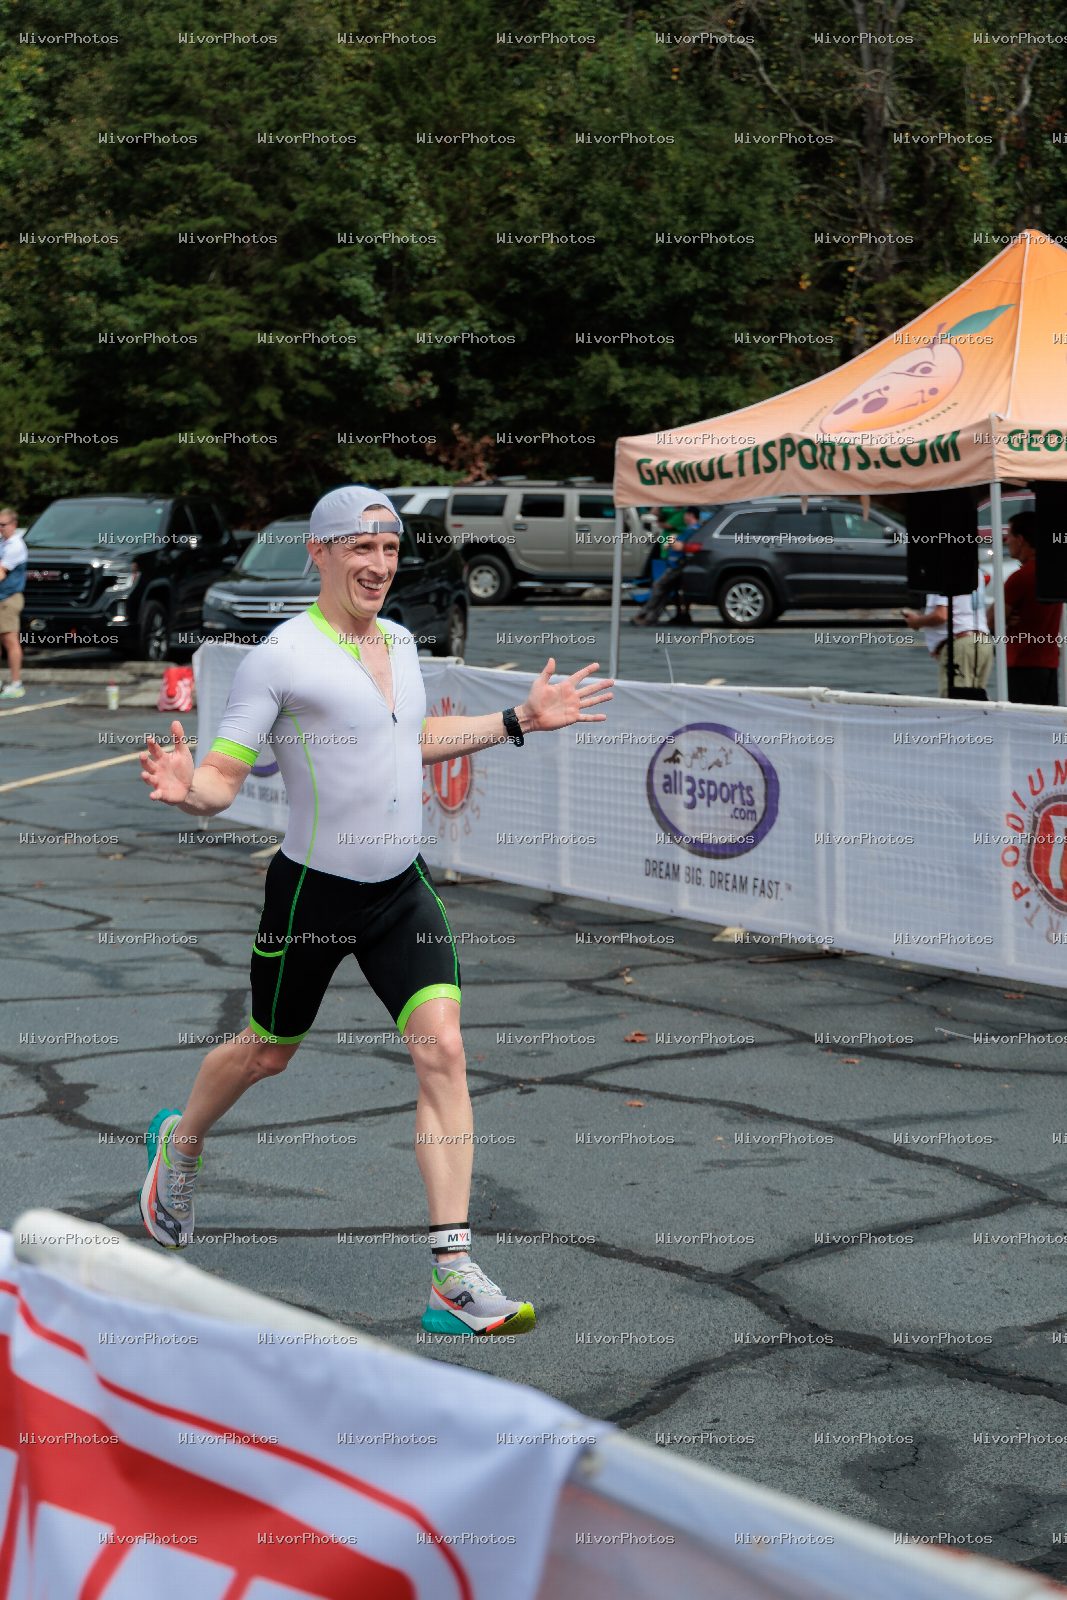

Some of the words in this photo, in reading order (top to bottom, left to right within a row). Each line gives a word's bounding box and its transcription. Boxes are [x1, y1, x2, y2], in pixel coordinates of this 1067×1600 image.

[1007, 429, 1067, 452] GEO
[644, 858, 680, 882] DREAM
[684, 865, 705, 888] BIG.
[709, 869, 748, 894] DREAM
